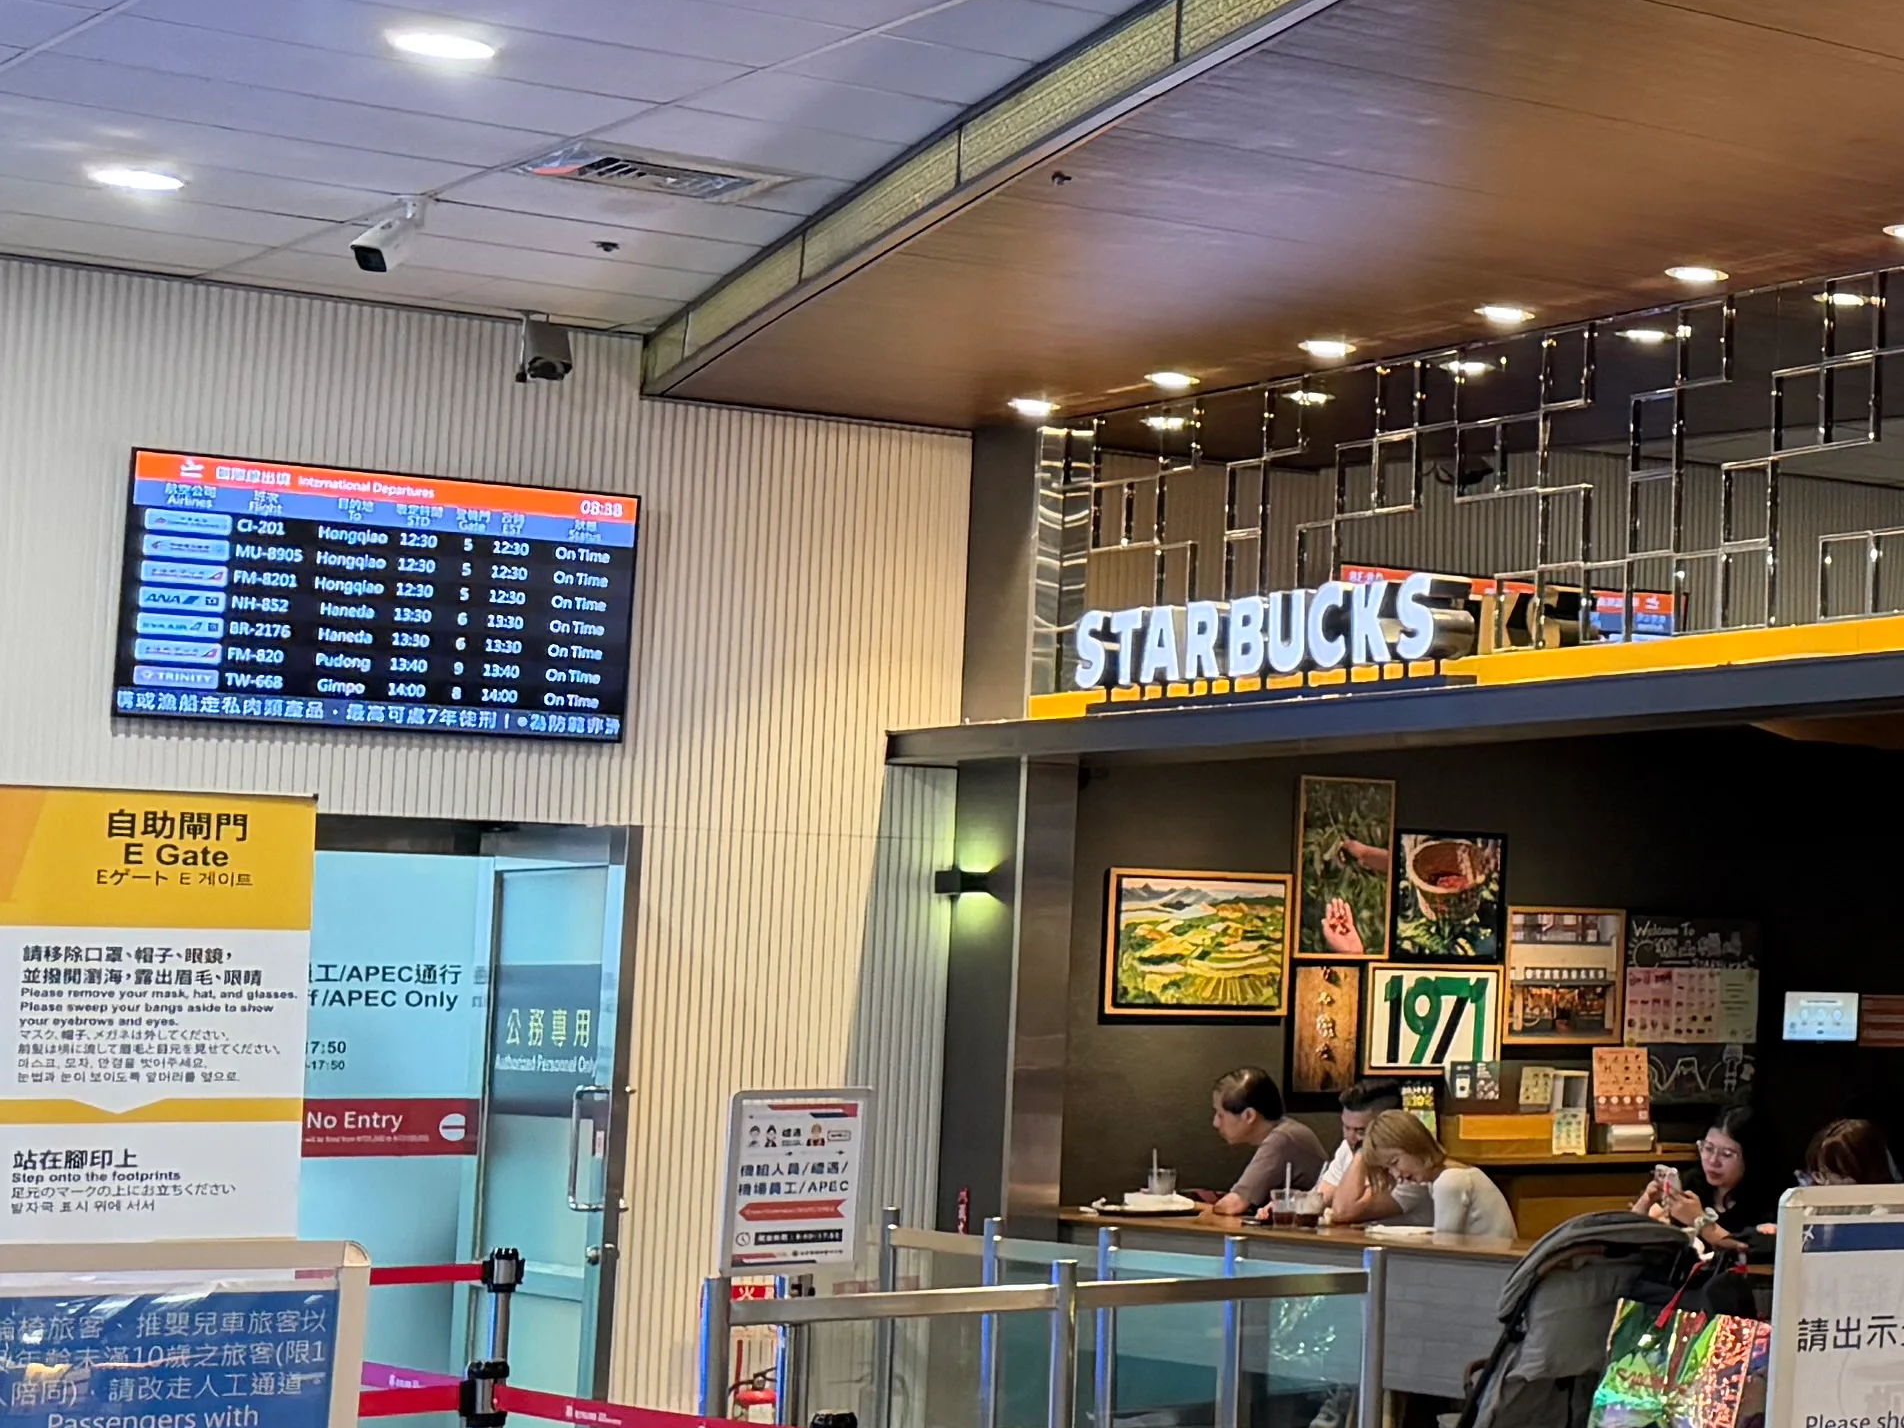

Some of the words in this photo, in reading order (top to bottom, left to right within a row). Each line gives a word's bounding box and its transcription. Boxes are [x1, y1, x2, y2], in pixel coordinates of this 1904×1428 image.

[298, 475, 370, 494] International
[373, 482, 435, 499] Departures
[318, 525, 389, 545] Hongqiao
[555, 546, 576, 560] On
[577, 548, 611, 564] Time
[316, 550, 387, 570] Hongqiao
[553, 571, 574, 585] On
[575, 572, 609, 588] Time
[144, 593, 181, 604] ANA
[314, 576, 384, 595] Hongqiao
[551, 595, 572, 610] On
[574, 596, 607, 612] Time
[320, 602, 376, 620] Haneda
[549, 619, 570, 634] On
[572, 620, 605, 637] Time
[1074, 573, 1436, 689] STARBUCKS
[318, 627, 373, 645] Haneda
[547, 644, 568, 659] On
[570, 645, 603, 661] Time
[156, 673, 213, 683] TRINITY
[315, 652, 372, 672] Pudong
[545, 668, 567, 684] On
[568, 669, 601, 685] Time
[317, 678, 366, 697] Gimpo
[544, 692, 565, 707] On
[566, 694, 599, 710] Time
[107, 808, 249, 842] 自助閘門
[124, 843, 144, 865] E
[156, 844, 229, 867] Gate
[96, 869, 168, 887] Eゲート
[180, 872, 191, 885] E
[198, 873, 253, 888] 게이트
[308, 963, 462, 985] 工/APEC通行
[20, 988, 64, 999] Please
[67, 989, 115, 999] remove
[118, 990, 148, 1001] your
[151, 988, 189, 1001] mask,
[193, 988, 217, 1001] hat,
[220, 988, 243, 999] and
[247, 988, 298, 1001] glasses.
[405, 990, 458, 1011] Only
[20, 1002, 64, 1013] Please
[67, 1003, 108, 1015] sweep
[111, 1004, 140, 1015] your
[144, 1002, 184, 1015] bangs
[187, 1002, 221, 1013] aside
[225, 1003, 237, 1013] to
[240, 1003, 274, 1013] show
[1384, 973, 1488, 1066] 1971
[20, 1017, 49, 1028] your
[52, 1015, 114, 1028] eyebrows
[118, 1016, 142, 1026] and
[146, 1017, 179, 1028] eyes.
[506, 1008, 591, 1048] 公務專用
[307, 1112, 337, 1129] No
[344, 1112, 403, 1133] Entry
[12, 1172, 45, 1184] Step
[49, 1172, 81, 1182] onto
[85, 1171, 107, 1182] the
[112, 1170, 181, 1184] footprints
[203, 1404, 259, 1428] with
